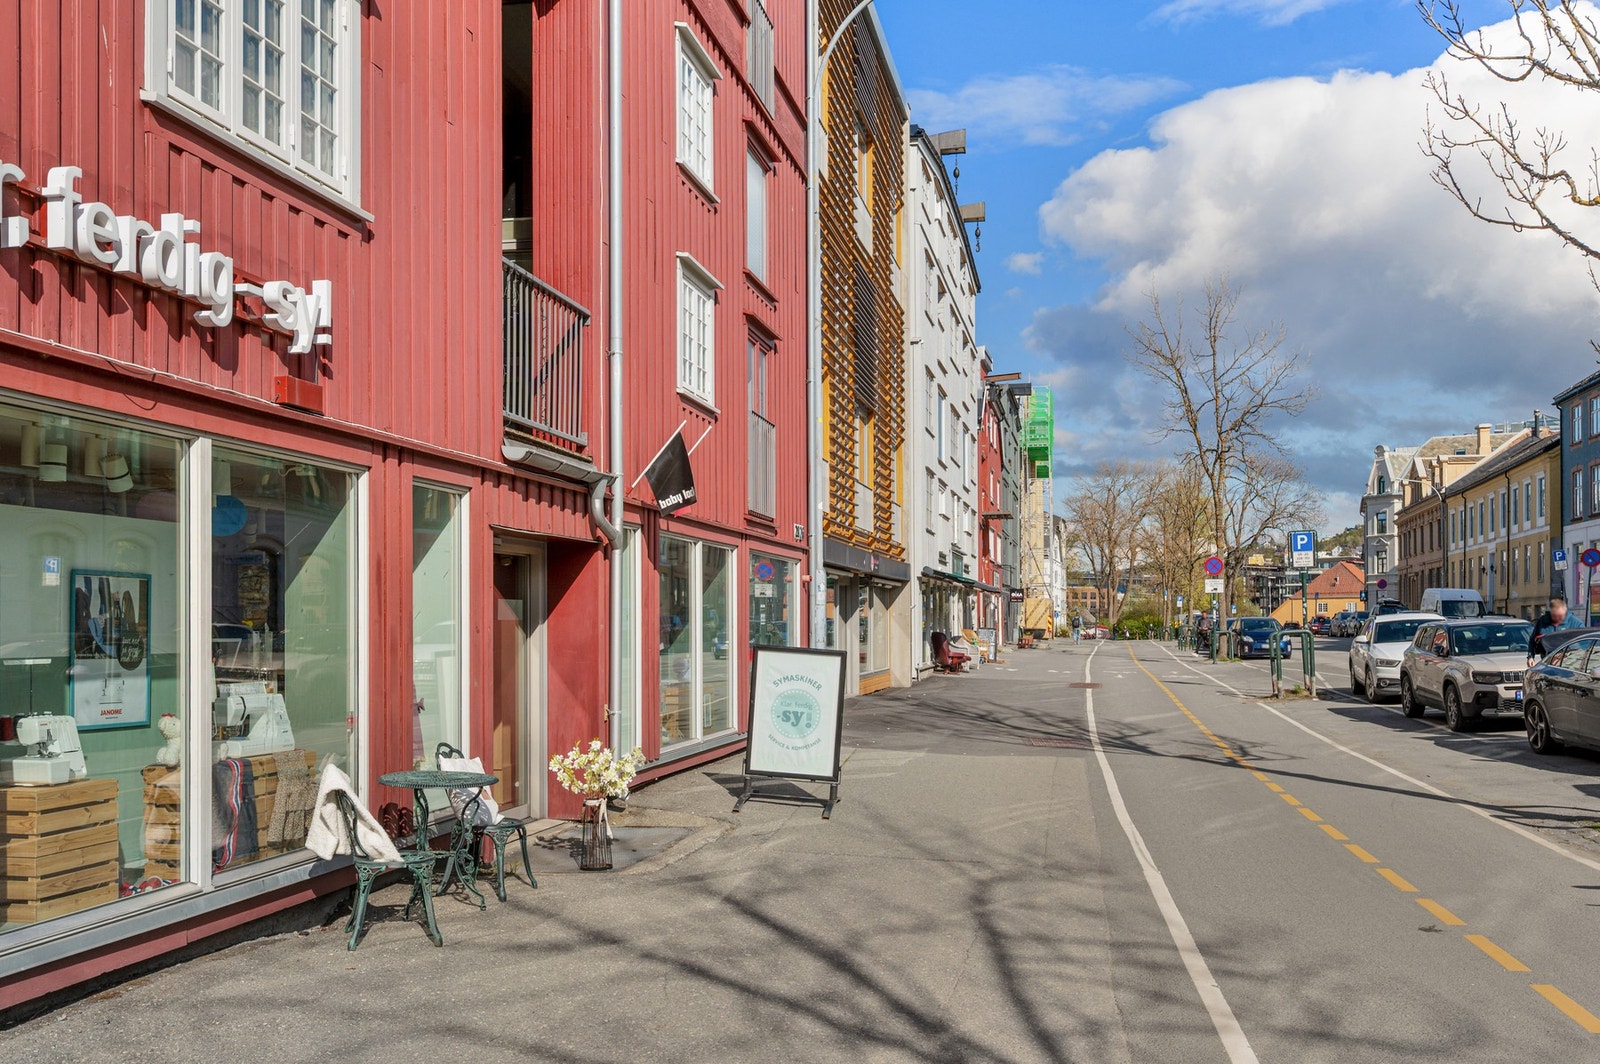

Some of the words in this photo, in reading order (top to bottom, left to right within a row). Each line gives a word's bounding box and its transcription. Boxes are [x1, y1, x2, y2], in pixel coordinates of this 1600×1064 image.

[659, 493, 683, 509] baby
[1297, 534, 1308, 550] P
[1555, 551, 1563, 560] P
[772, 674, 822, 691] SYMASKINER
[100, 708, 122, 716] JANOME
[768, 733, 785, 748] SERVICE
[791, 737, 822, 751] KOMPETANSE
